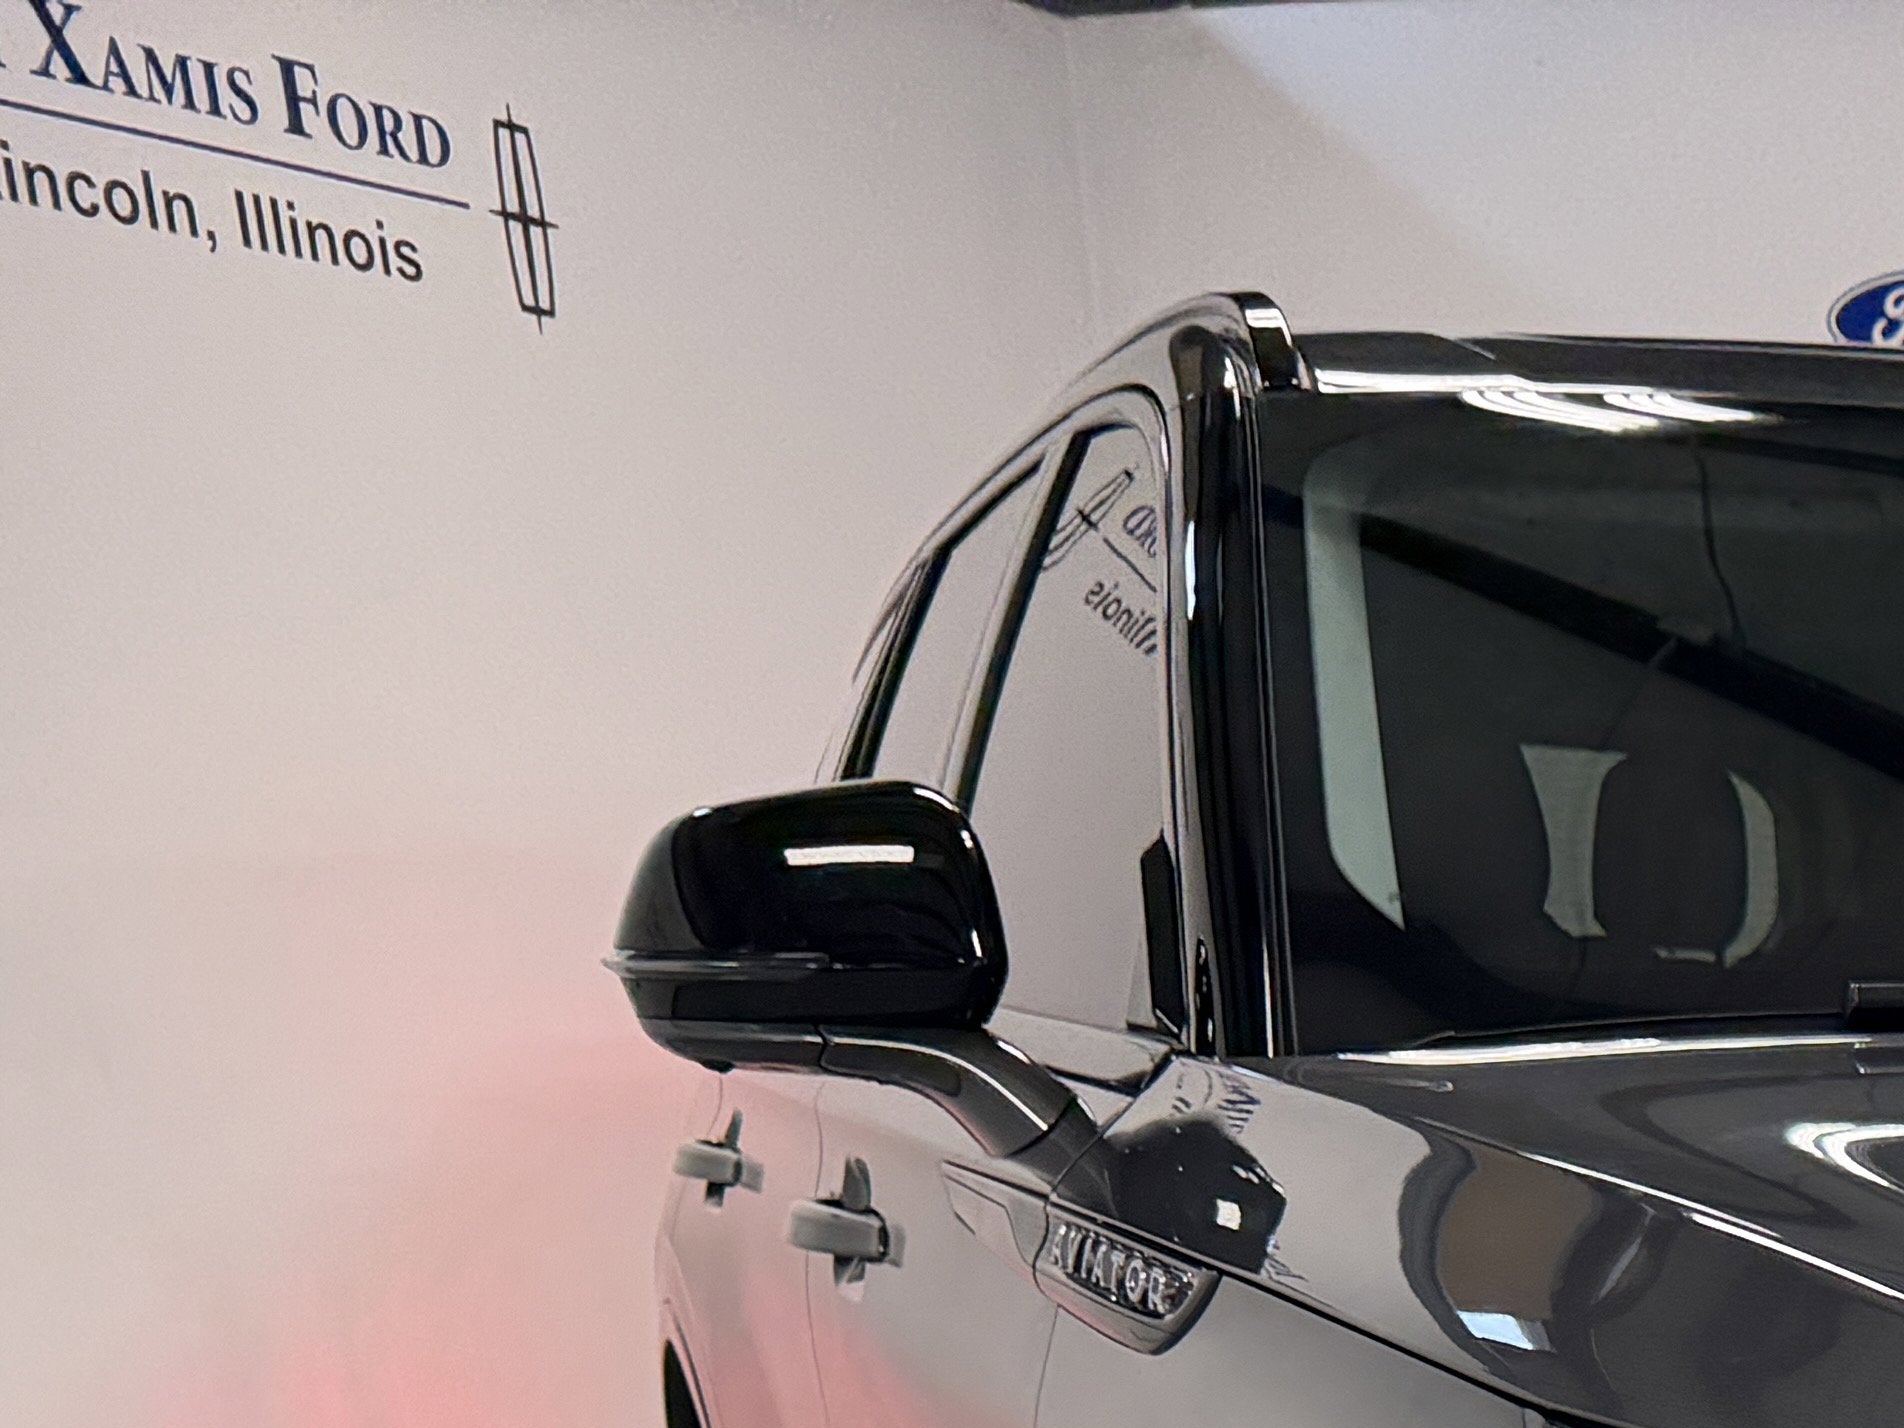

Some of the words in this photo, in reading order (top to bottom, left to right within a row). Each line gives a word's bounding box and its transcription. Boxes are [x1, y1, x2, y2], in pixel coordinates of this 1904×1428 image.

[28, 0, 260, 127] XAMIS
[271, 53, 452, 168] FORD
[0, 138, 218, 253] incoln,
[233, 189, 424, 282] Illinois
[1051, 1224, 1166, 1314] AVIATOR
